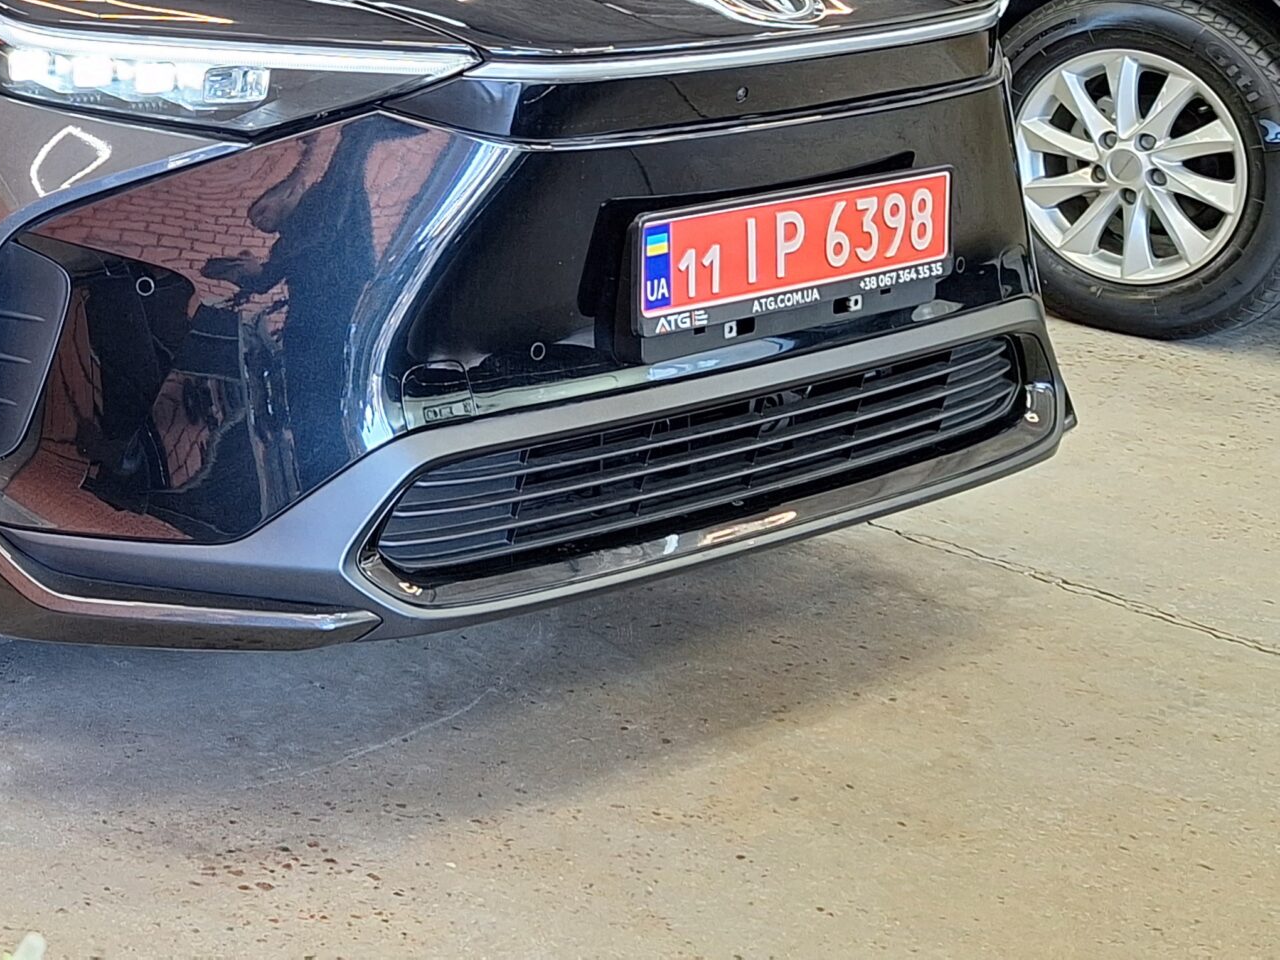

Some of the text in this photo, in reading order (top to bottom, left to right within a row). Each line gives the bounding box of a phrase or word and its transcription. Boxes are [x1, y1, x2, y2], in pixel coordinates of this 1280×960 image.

[1205, 41, 1260, 102] Giti
[678, 244, 721, 298] 11
[826, 187, 934, 268] 6398
[878, 271, 898, 287] 067
[897, 267, 918, 283] 364
[917, 264, 930, 279] 35
[930, 261, 943, 276] 35
[646, 278, 669, 302] UA
[752, 288, 820, 313] ATG.COM.UA
